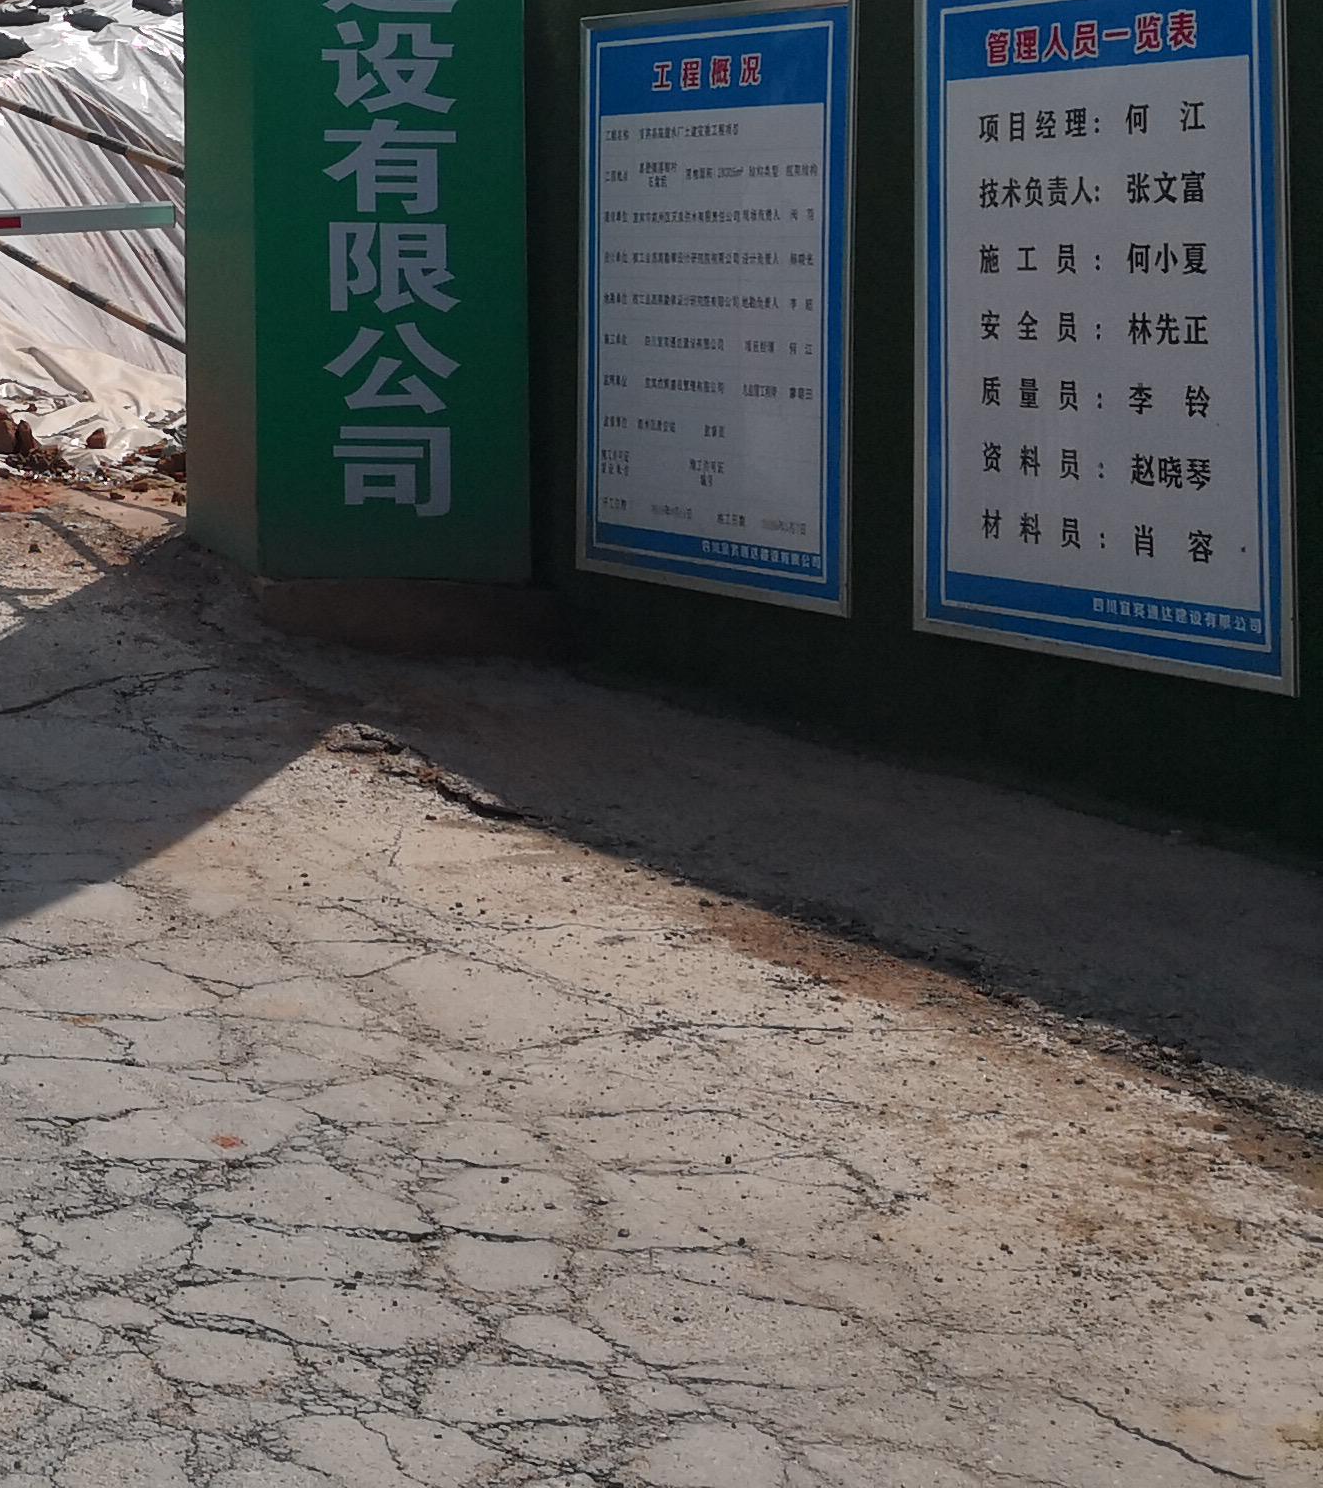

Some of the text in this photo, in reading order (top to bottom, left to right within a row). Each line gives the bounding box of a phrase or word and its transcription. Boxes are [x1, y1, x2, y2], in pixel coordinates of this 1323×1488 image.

[986, 10, 1197, 66] 管理人员一览表
[652, 54, 761, 91] 工程概况
[1092, 597, 1262, 635] 四川宜宾通达建设有限公司
